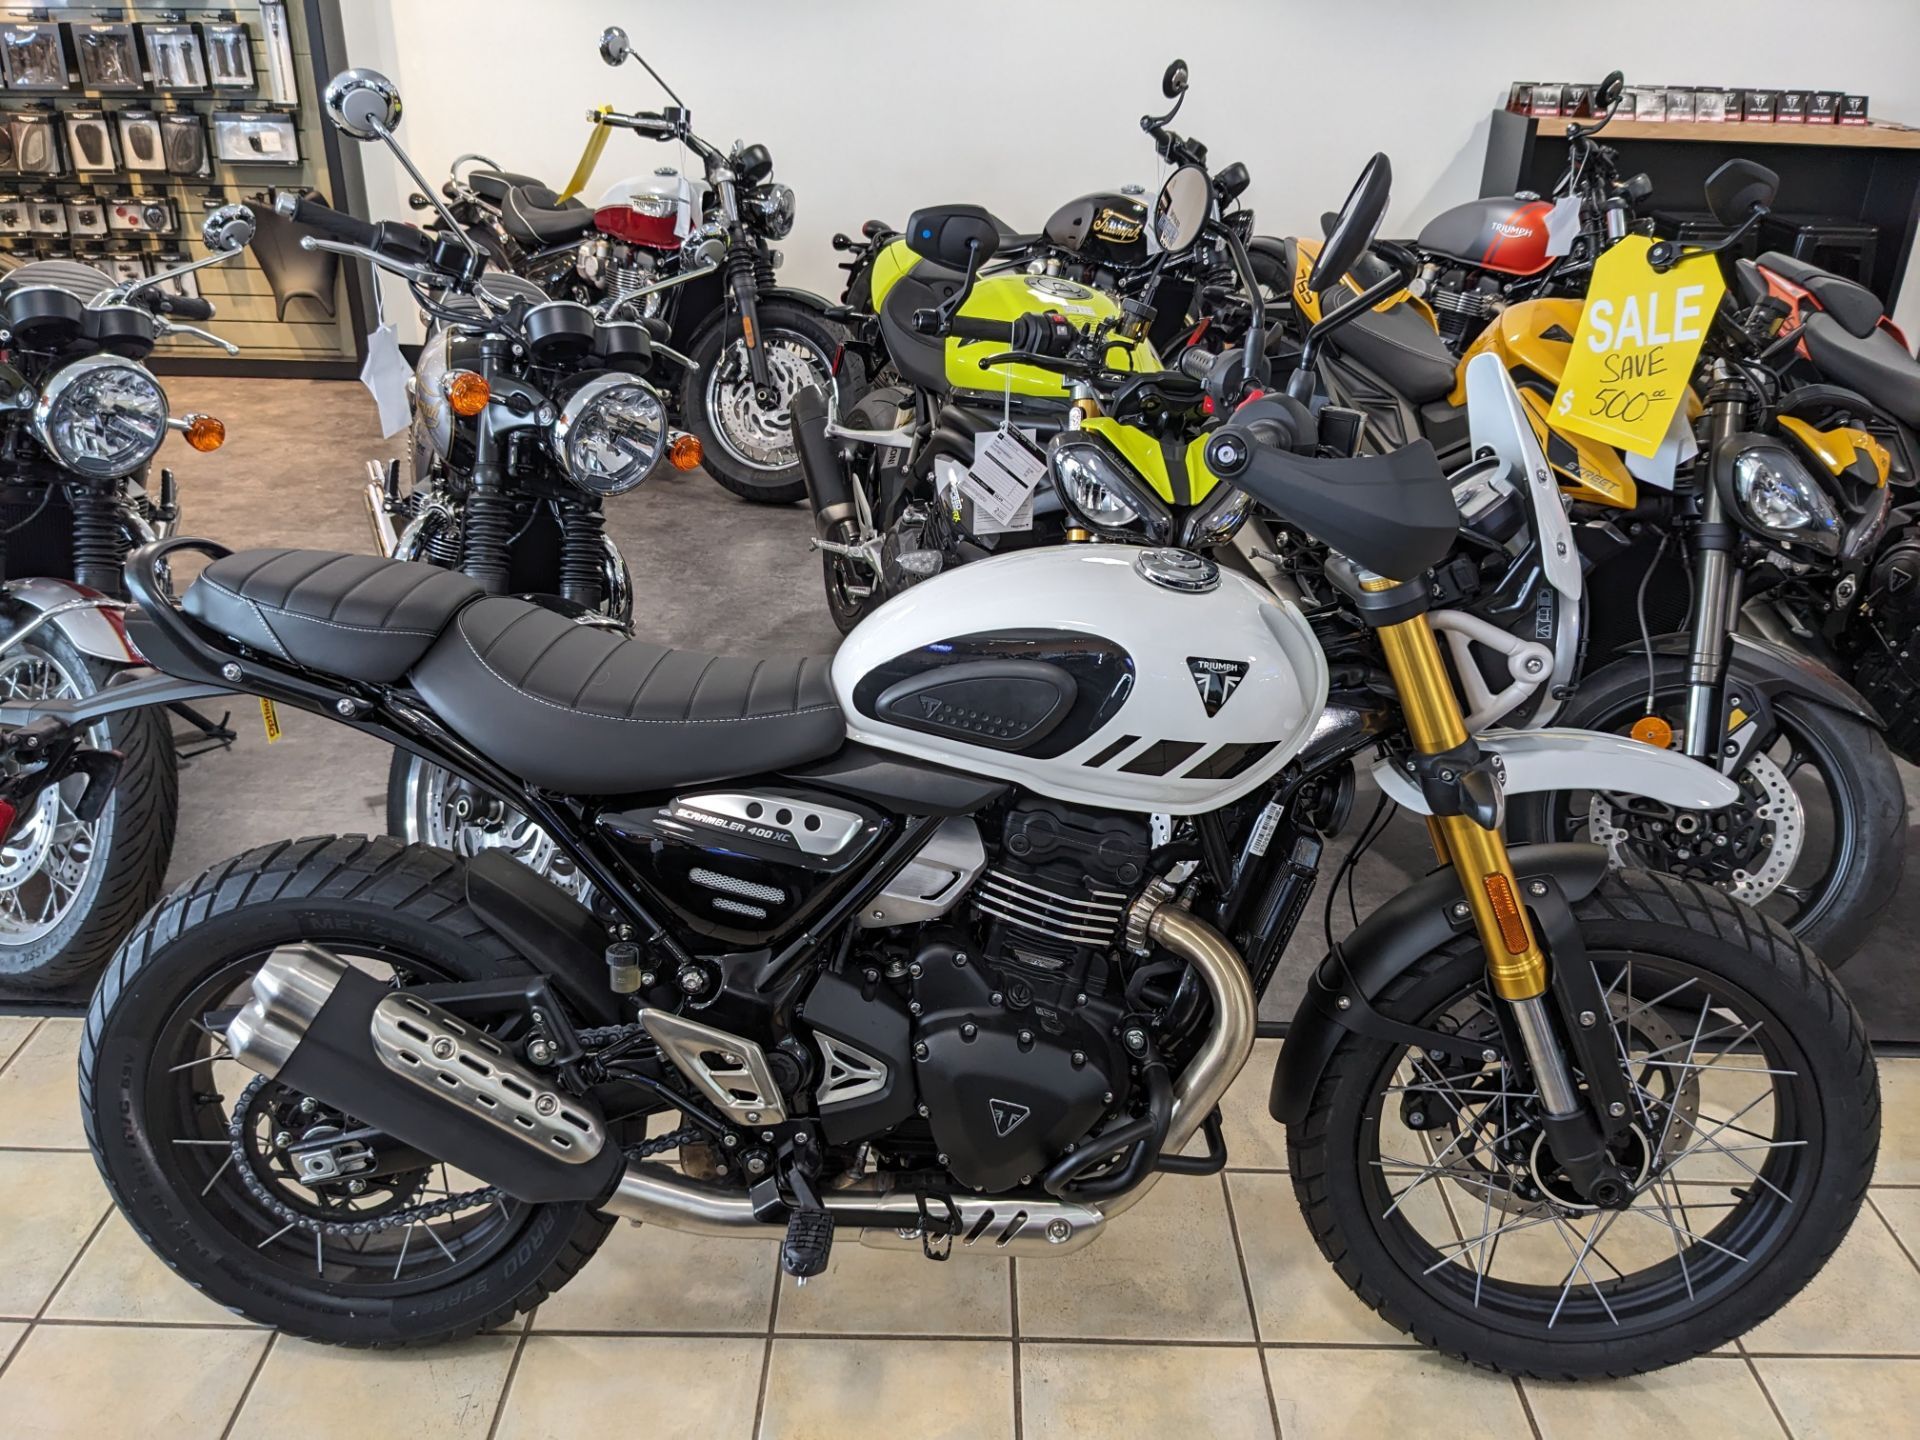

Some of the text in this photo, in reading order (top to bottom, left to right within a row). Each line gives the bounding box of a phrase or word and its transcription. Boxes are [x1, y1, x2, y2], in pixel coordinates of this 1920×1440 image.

[1092, 209, 1144, 241] Triumph
[1491, 222, 1533, 238] TRIUMPH
[1588, 284, 1704, 353] SALE
[1600, 346, 1668, 383] SAVE
[1558, 389, 1575, 416] $
[1198, 661, 1238, 672] TRIUMPH
[676, 808, 791, 842] SCRAMBLER 400 XC
